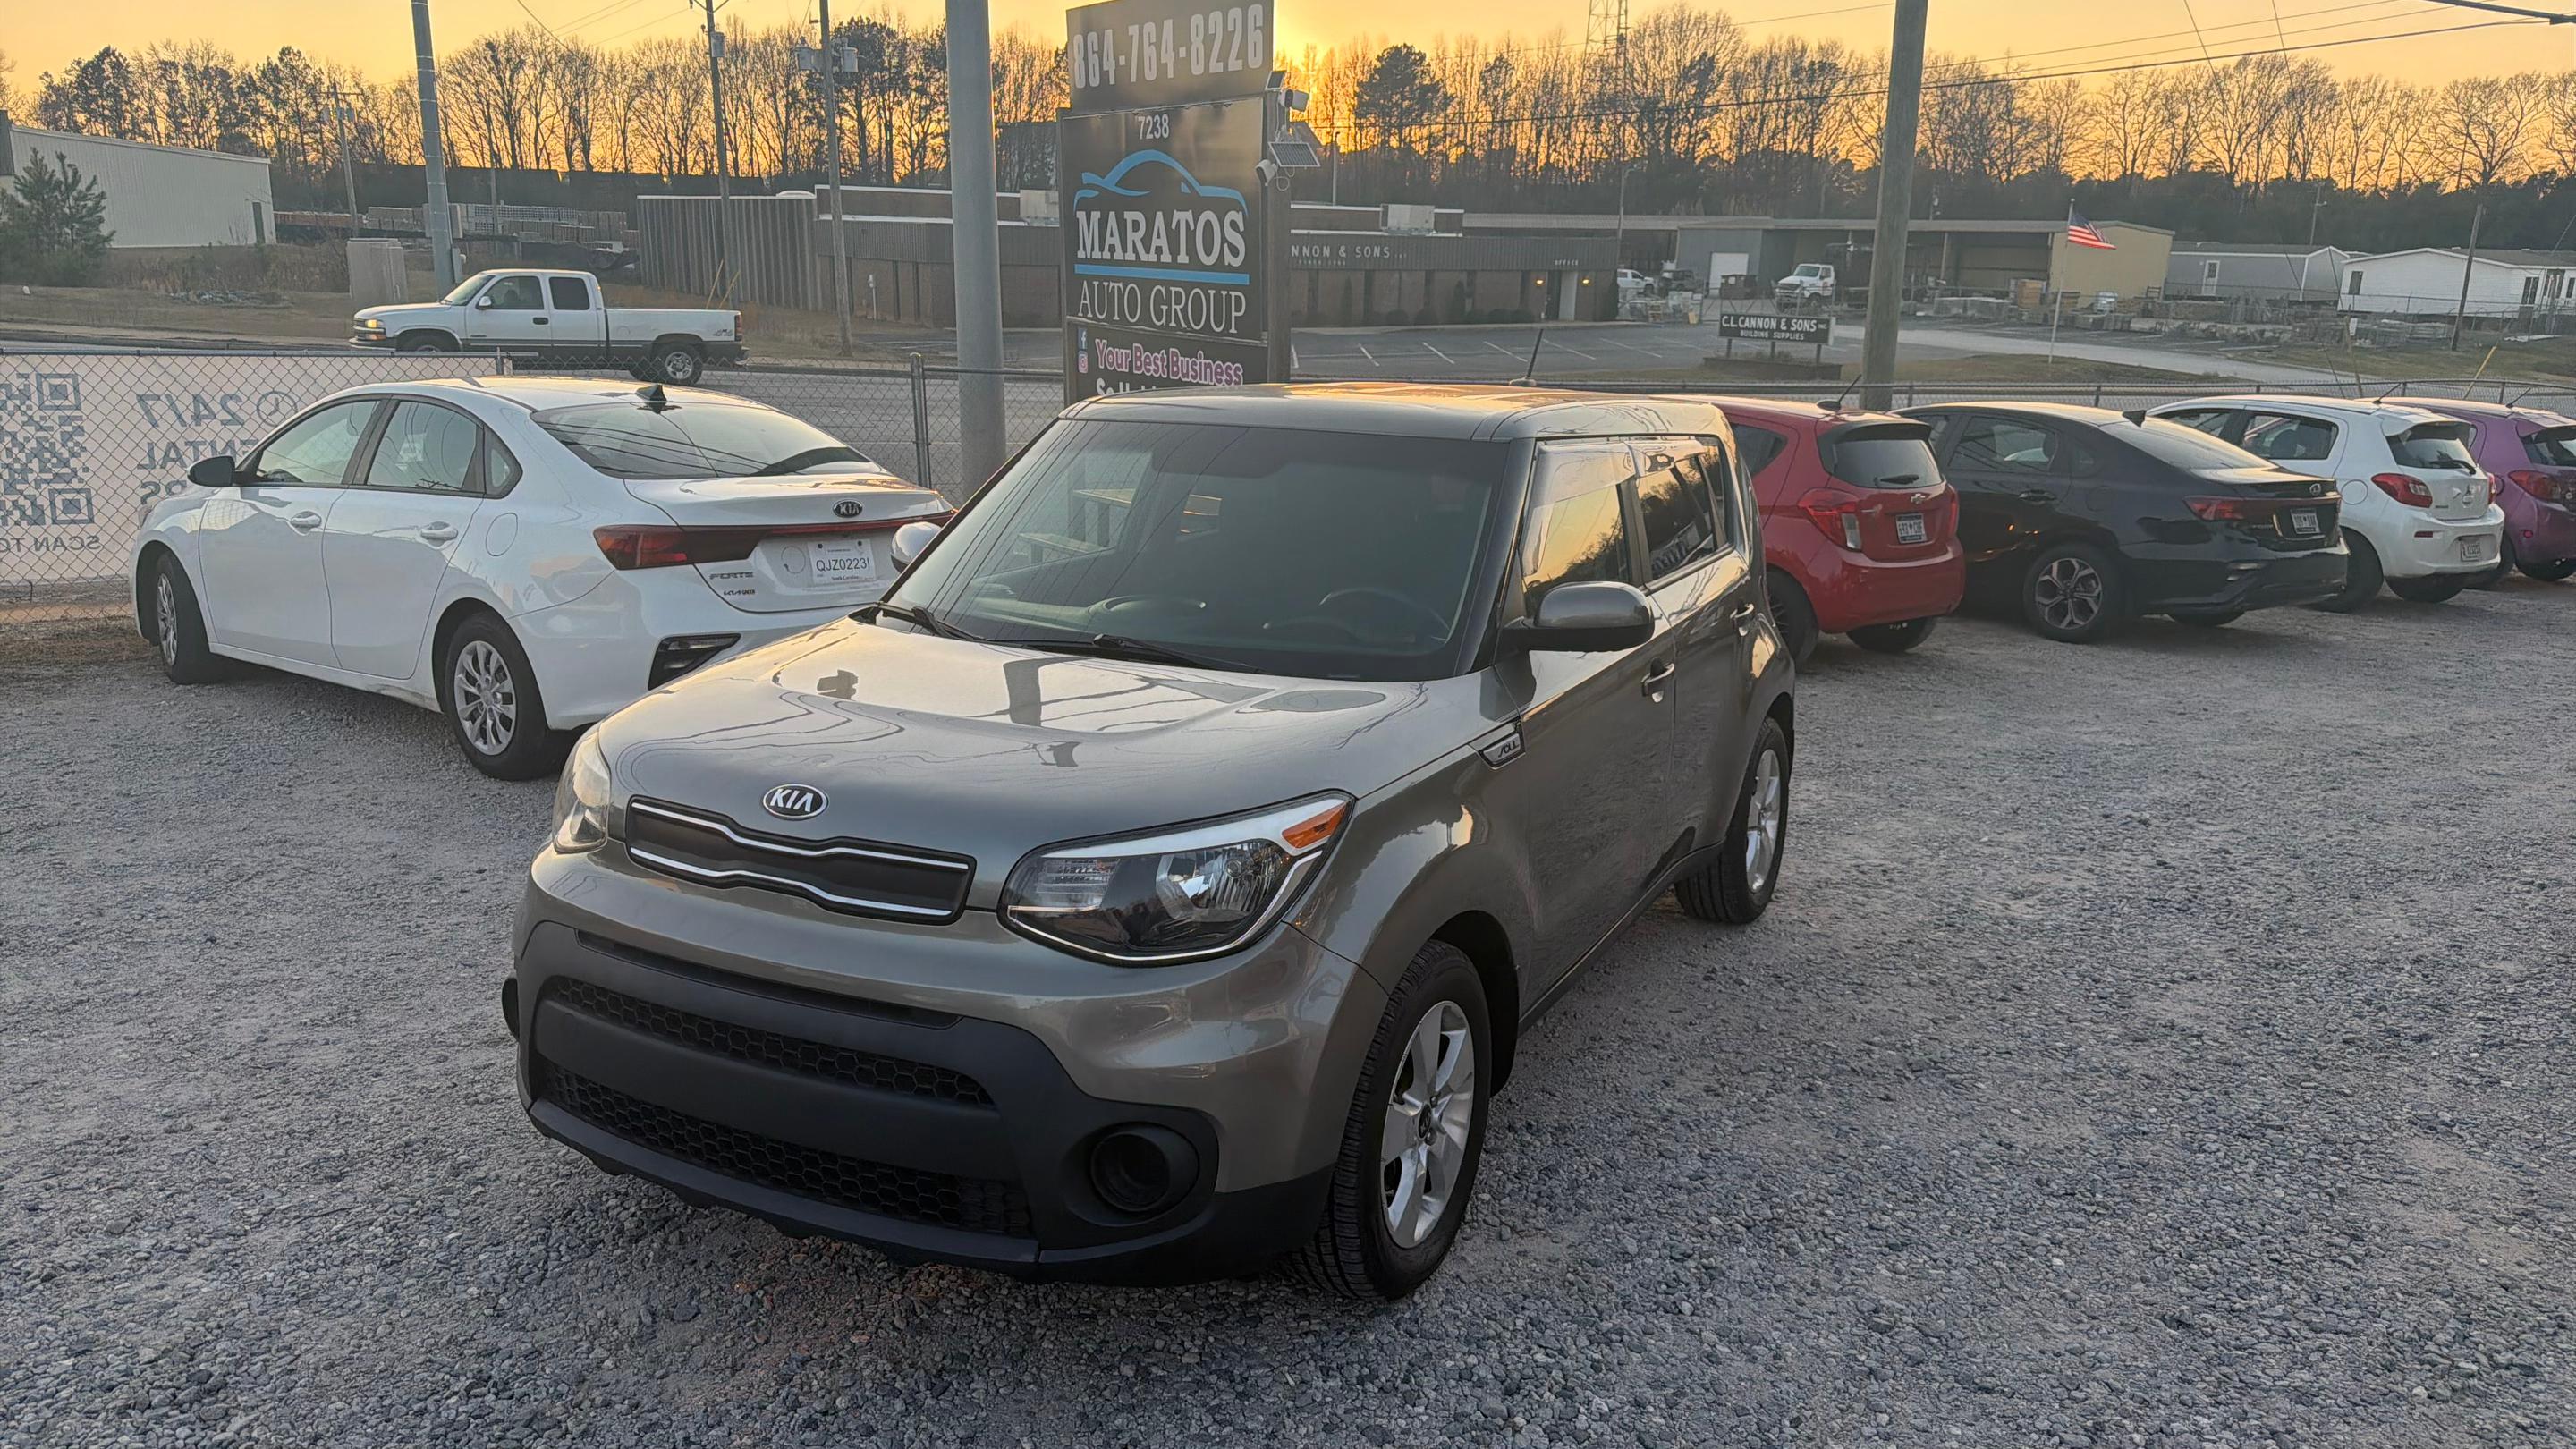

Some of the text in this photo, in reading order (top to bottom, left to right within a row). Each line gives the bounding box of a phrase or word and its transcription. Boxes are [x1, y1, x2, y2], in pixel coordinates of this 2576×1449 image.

[1073, 4, 1263, 89] 864-764-8226
[1138, 114, 1169, 140] 7238
[1076, 209, 1246, 267] MARATOS
[1292, 245, 1390, 258] NNON & SONS
[1078, 280, 1246, 334] AUTO GROUP
[1738, 316, 1776, 330] CANNON
[1790, 318, 1817, 332] SONS
[1740, 329, 1804, 340] BUILDING SUPPLIES
[1095, 338, 1243, 386] Your Best Business
[840, 504, 859, 514] KIA
[709, 572, 753, 580] FORTE
[770, 788, 814, 812] KIA
